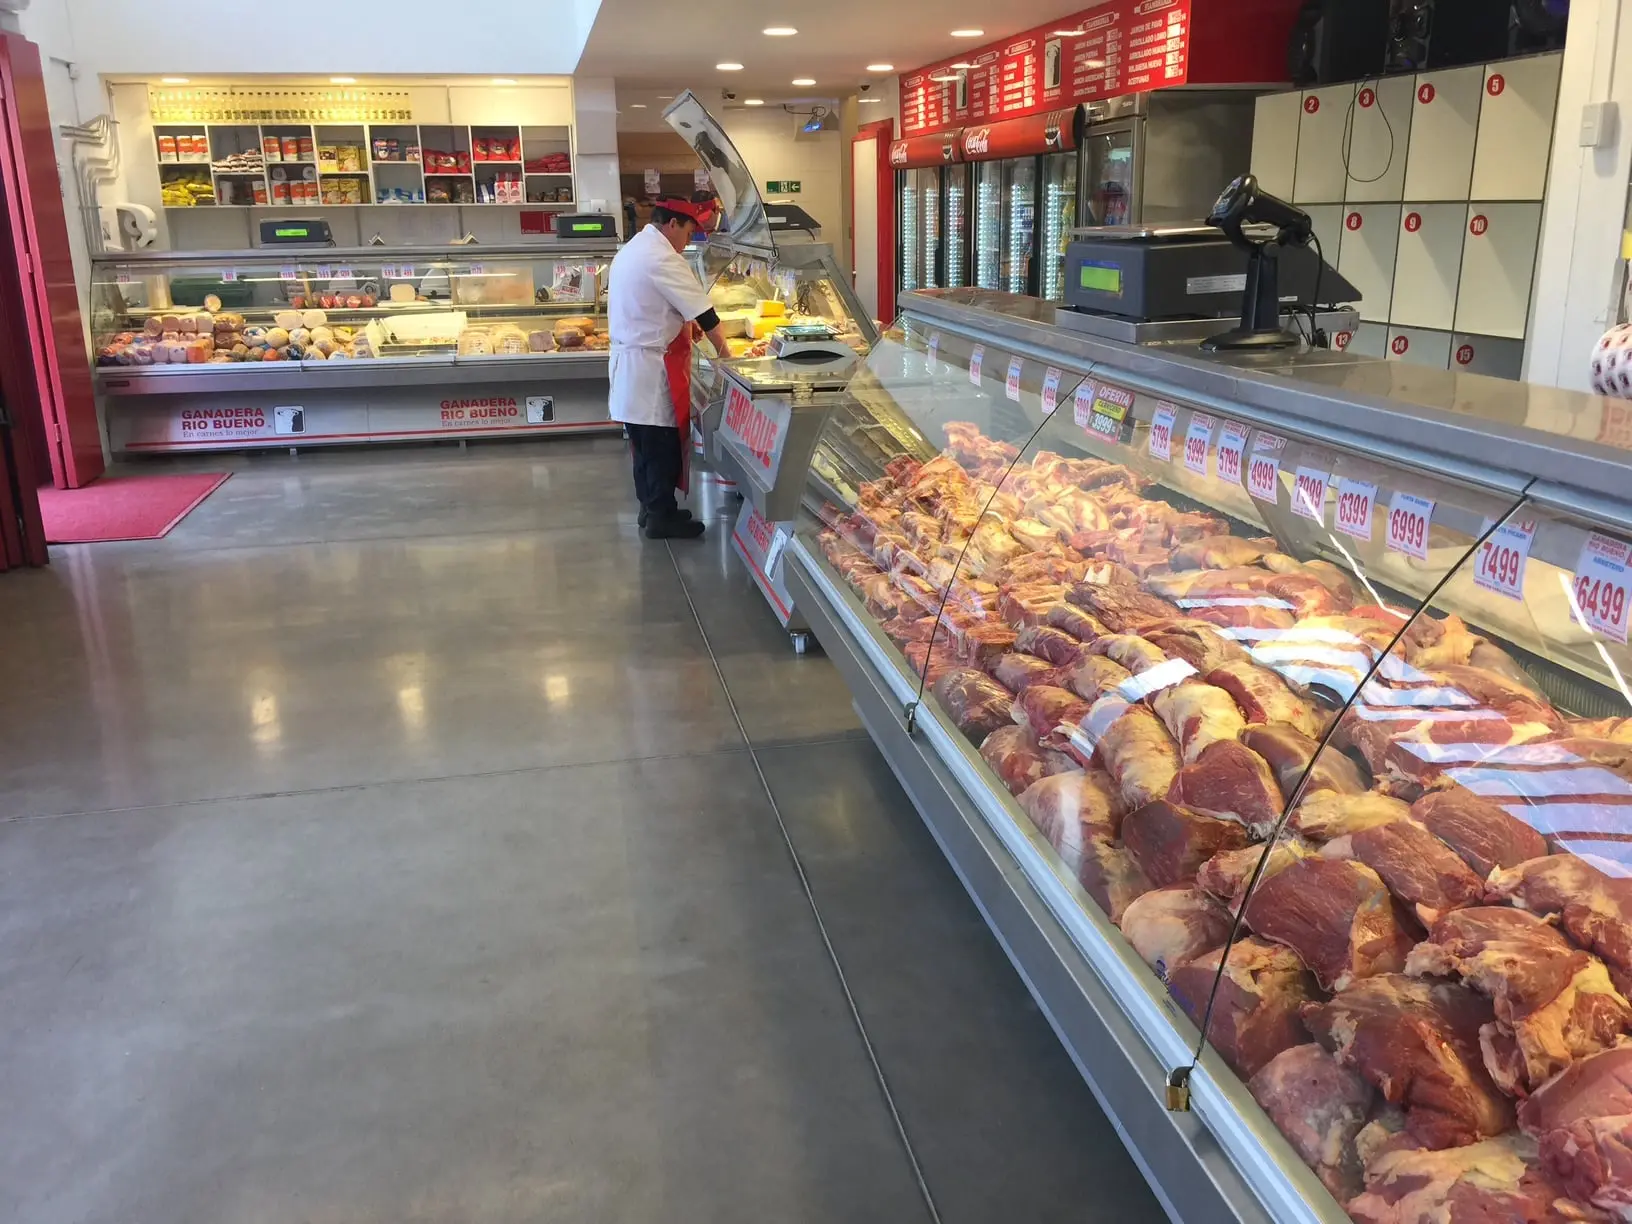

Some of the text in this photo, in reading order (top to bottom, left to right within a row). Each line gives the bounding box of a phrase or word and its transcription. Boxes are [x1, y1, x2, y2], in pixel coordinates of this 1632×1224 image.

[1473, 219, 1484, 232] 10
[1338, 333, 1348, 345] 13
[1394, 339, 1406, 351] 14
[1459, 348, 1470, 361] 15
[1099, 386, 1131, 406] OFERTA
[440, 398, 517, 410] GANADERA
[182, 407, 264, 420] GANADERA
[441, 407, 518, 420] RIO BUENO
[182, 418, 265, 431] RIO BUENO
[726, 388, 778, 468] EMPAQUE
[197, 429, 224, 438] carnes
[1251, 459, 1274, 491] 4999
